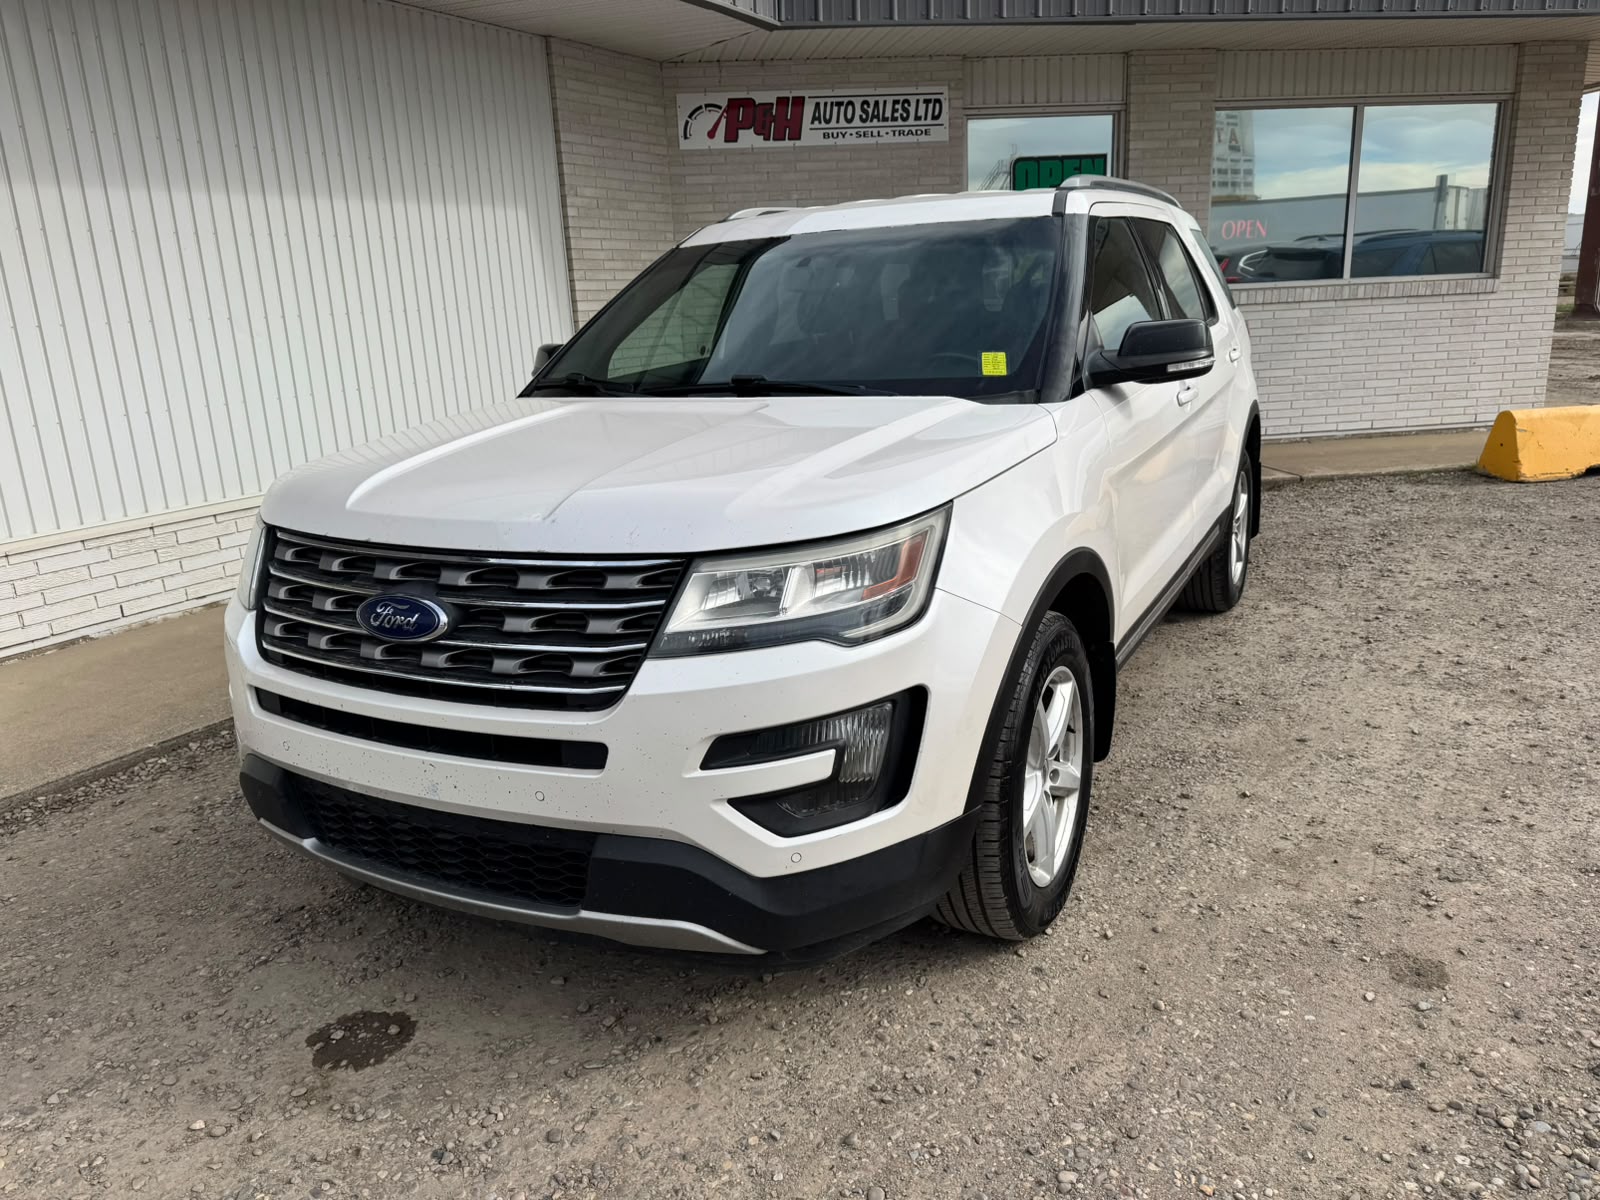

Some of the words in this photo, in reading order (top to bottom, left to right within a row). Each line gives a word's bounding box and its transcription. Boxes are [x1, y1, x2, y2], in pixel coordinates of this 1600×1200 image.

[810, 100, 856, 125] AUTO
[859, 98, 911, 124] SALES
[913, 97, 943, 121] LTD
[822, 131, 848, 140] BUY
[855, 130, 884, 138] SELL
[890, 128, 931, 137] TRADE
[1221, 219, 1268, 240] OPEN
[369, 601, 421, 632] Ford
